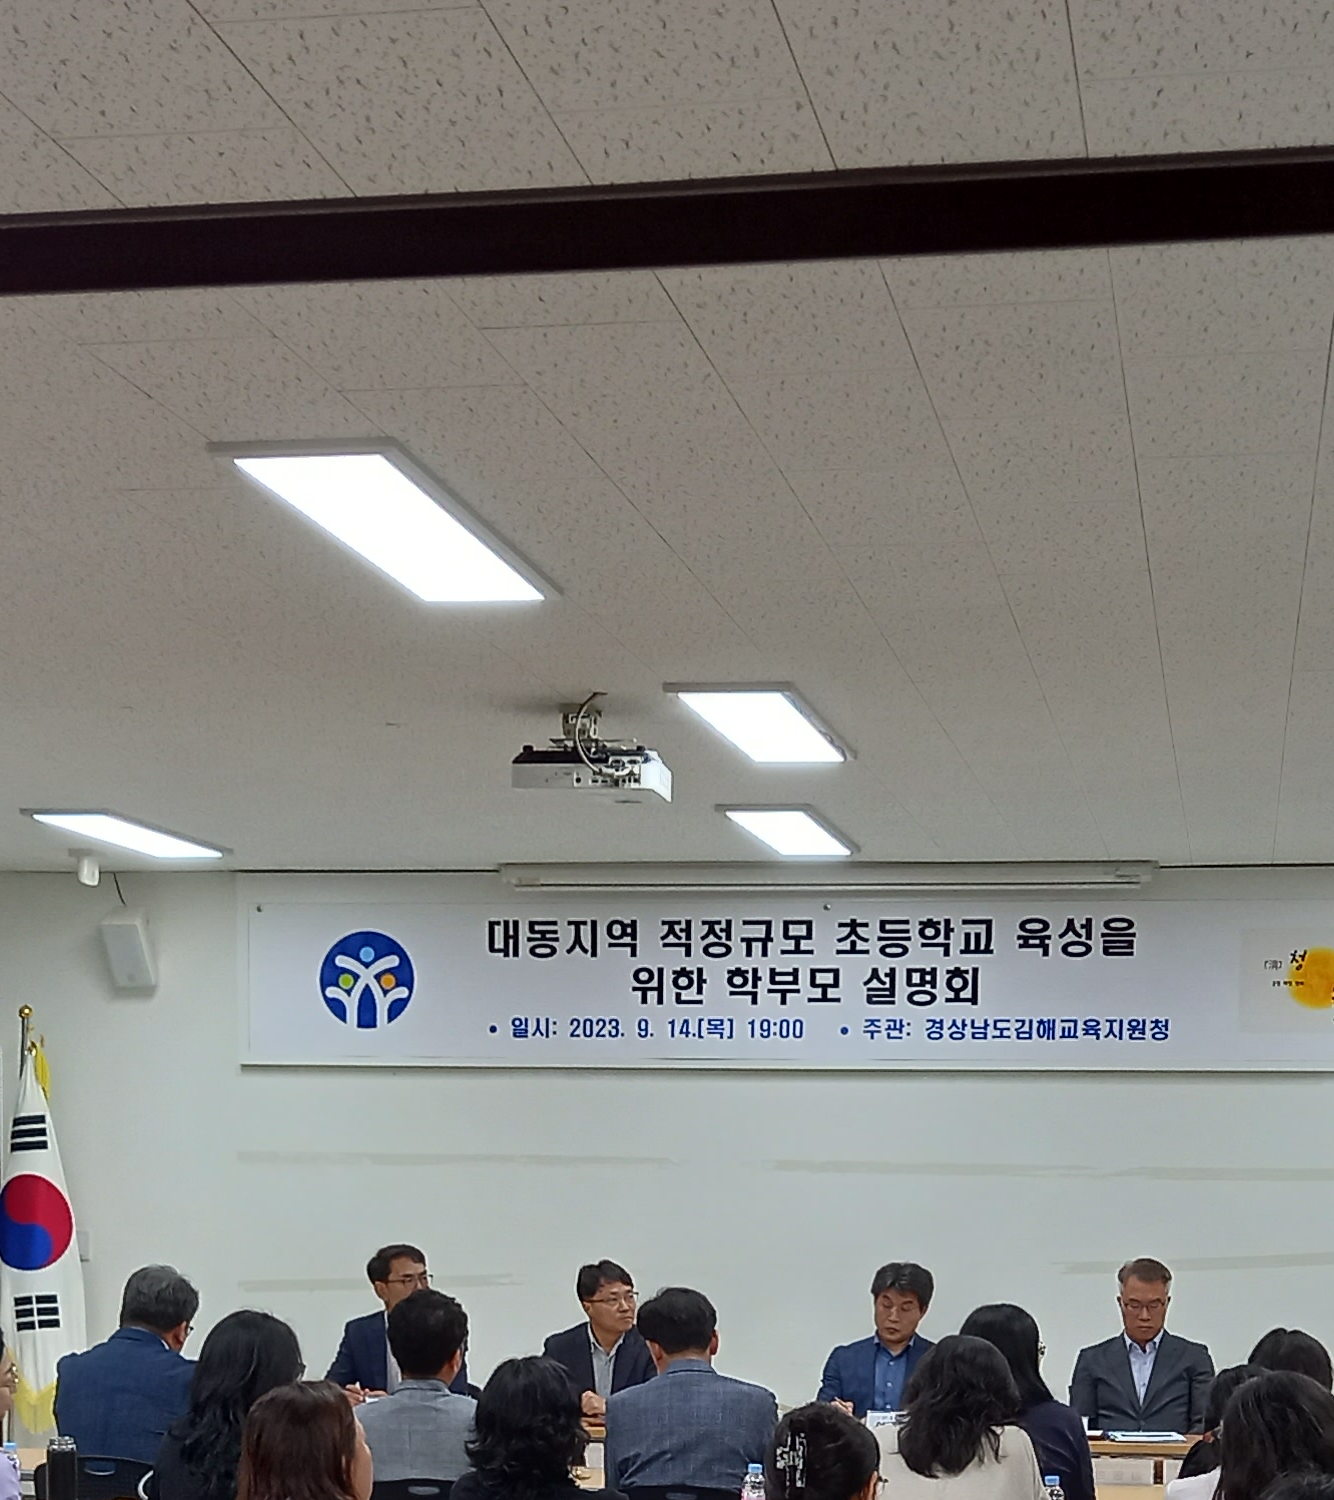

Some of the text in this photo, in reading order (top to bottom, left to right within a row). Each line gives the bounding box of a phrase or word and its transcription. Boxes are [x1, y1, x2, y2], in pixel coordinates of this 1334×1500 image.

[487, 917, 1138, 958] 대동지역 적정규모 초등학교 육성을
[1289, 949, 1308, 971] 청
[631, 966, 980, 1006] 위한 학부모 설명회
[511, 1017, 804, 1039] 일시: 2023. 9. 14.[목] 19:00
[862, 1018, 1170, 1041] 주관: 경상남도김해교육지원청
